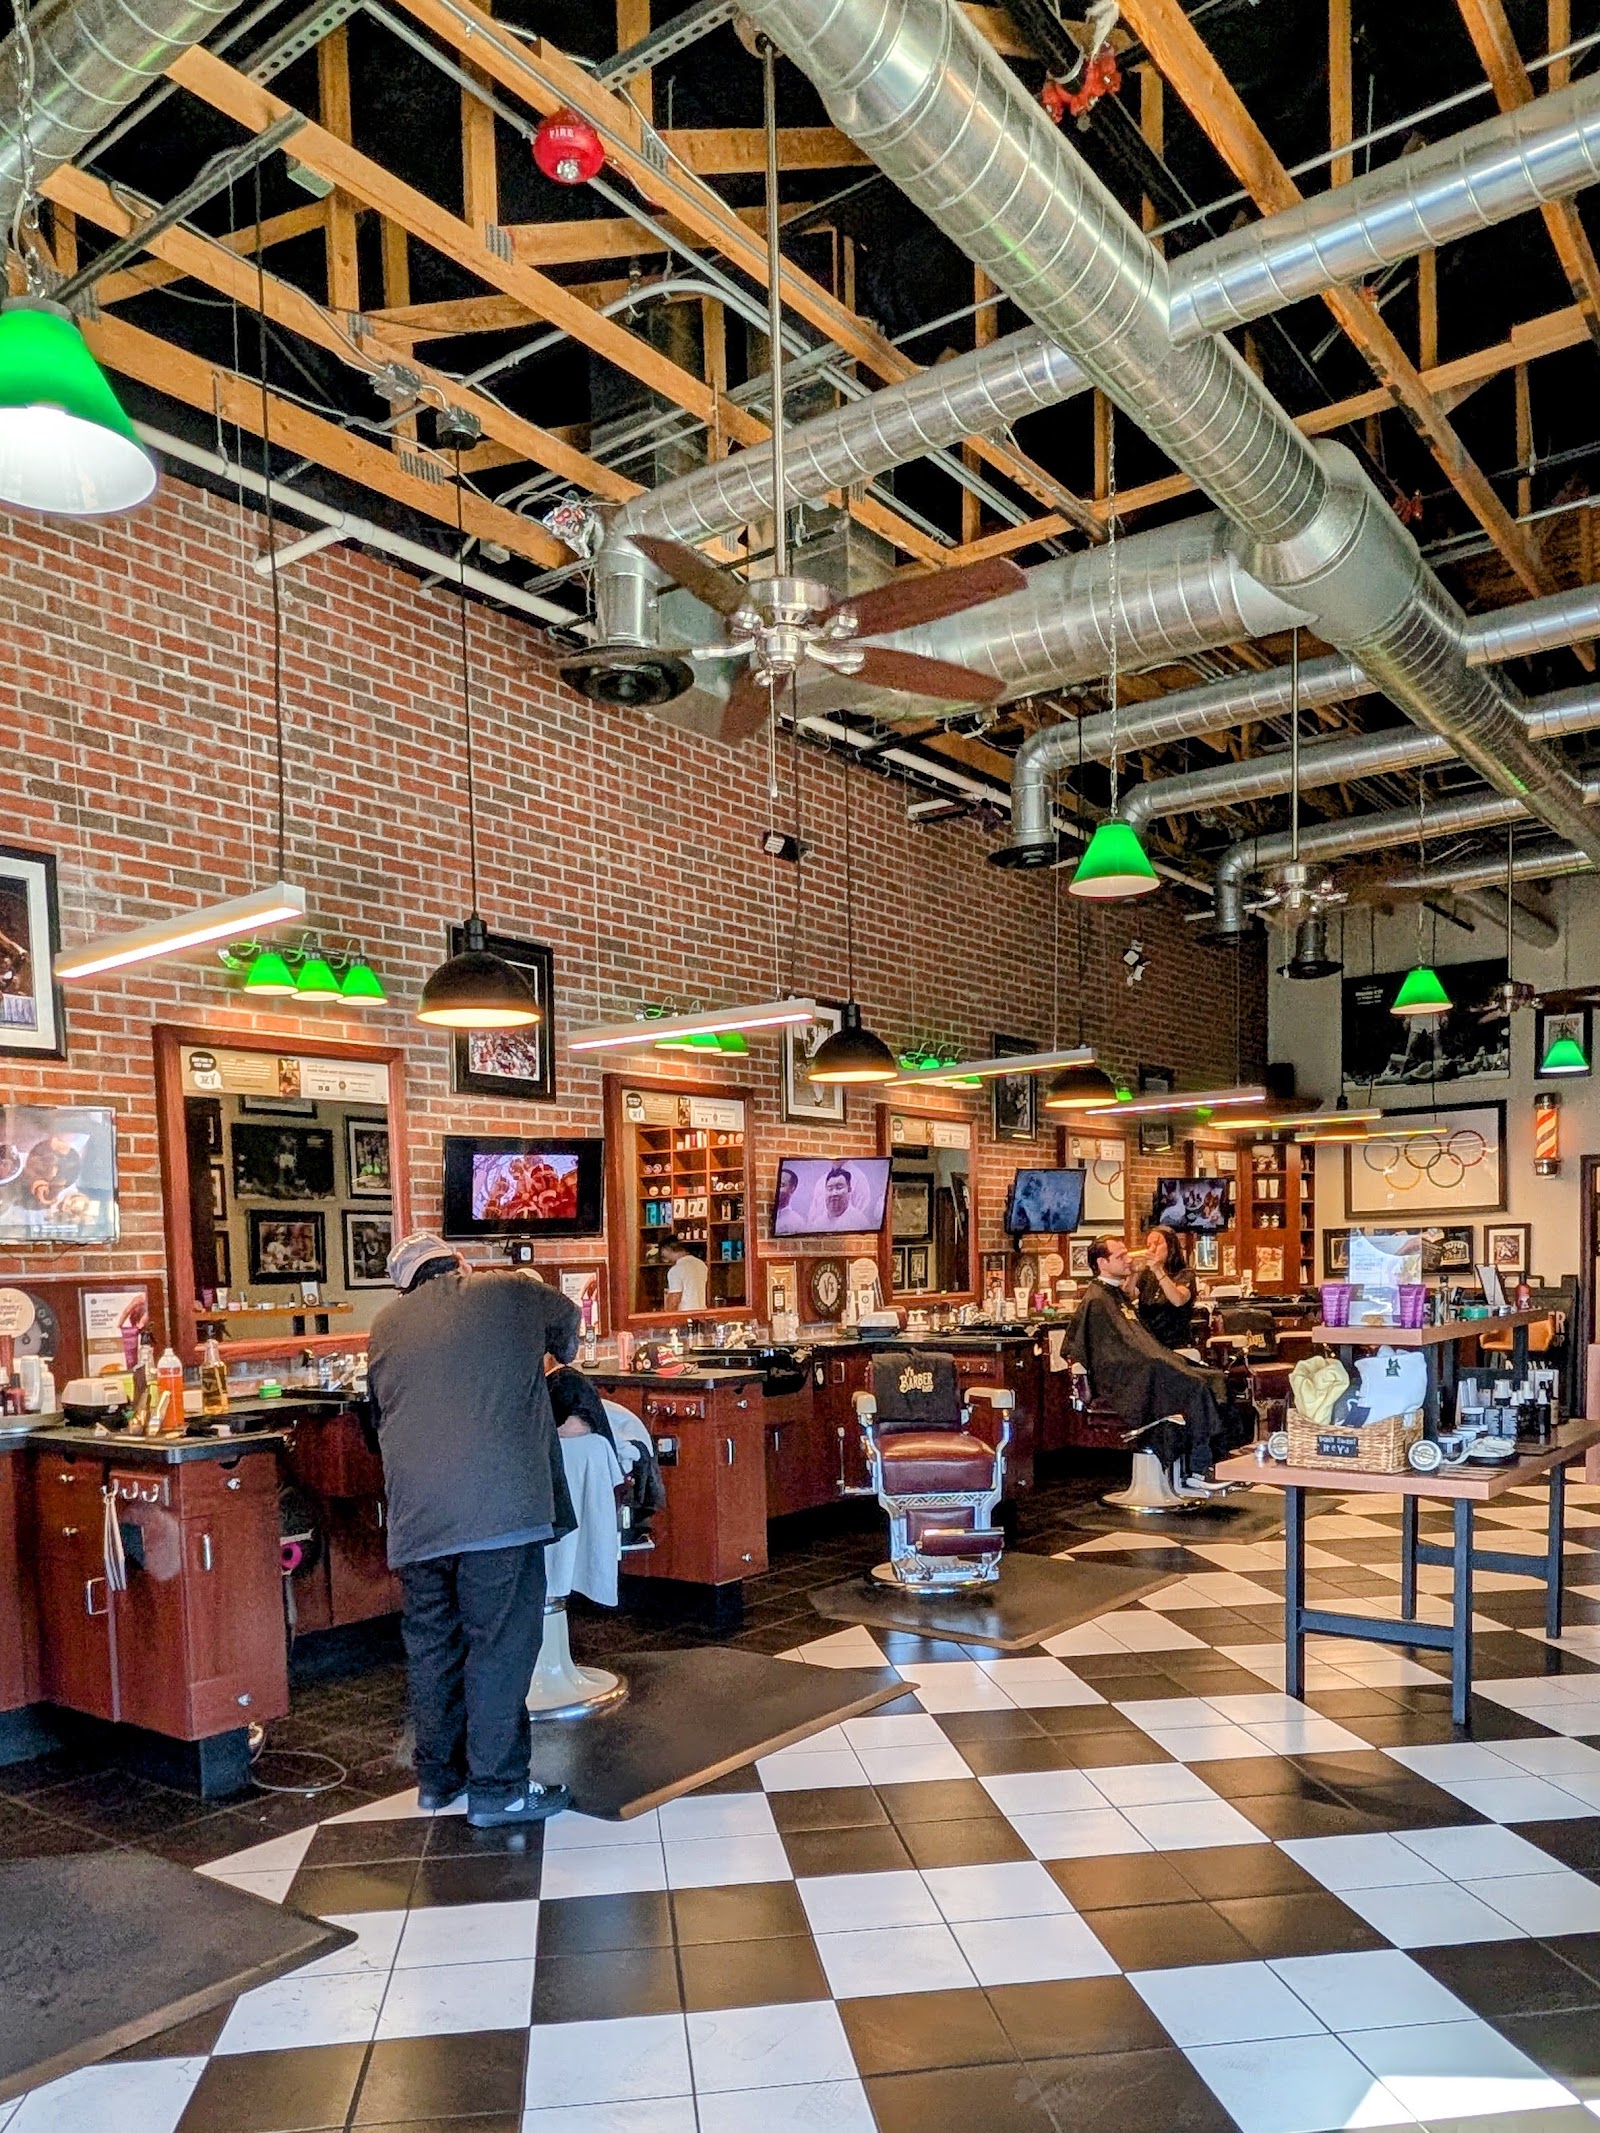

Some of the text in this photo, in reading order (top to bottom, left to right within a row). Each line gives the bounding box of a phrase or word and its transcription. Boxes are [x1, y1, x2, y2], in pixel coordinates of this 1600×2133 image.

[549, 127, 575, 138] FIRE
[904, 1366, 914, 1377] V's
[899, 1372, 934, 1393] BARBER
